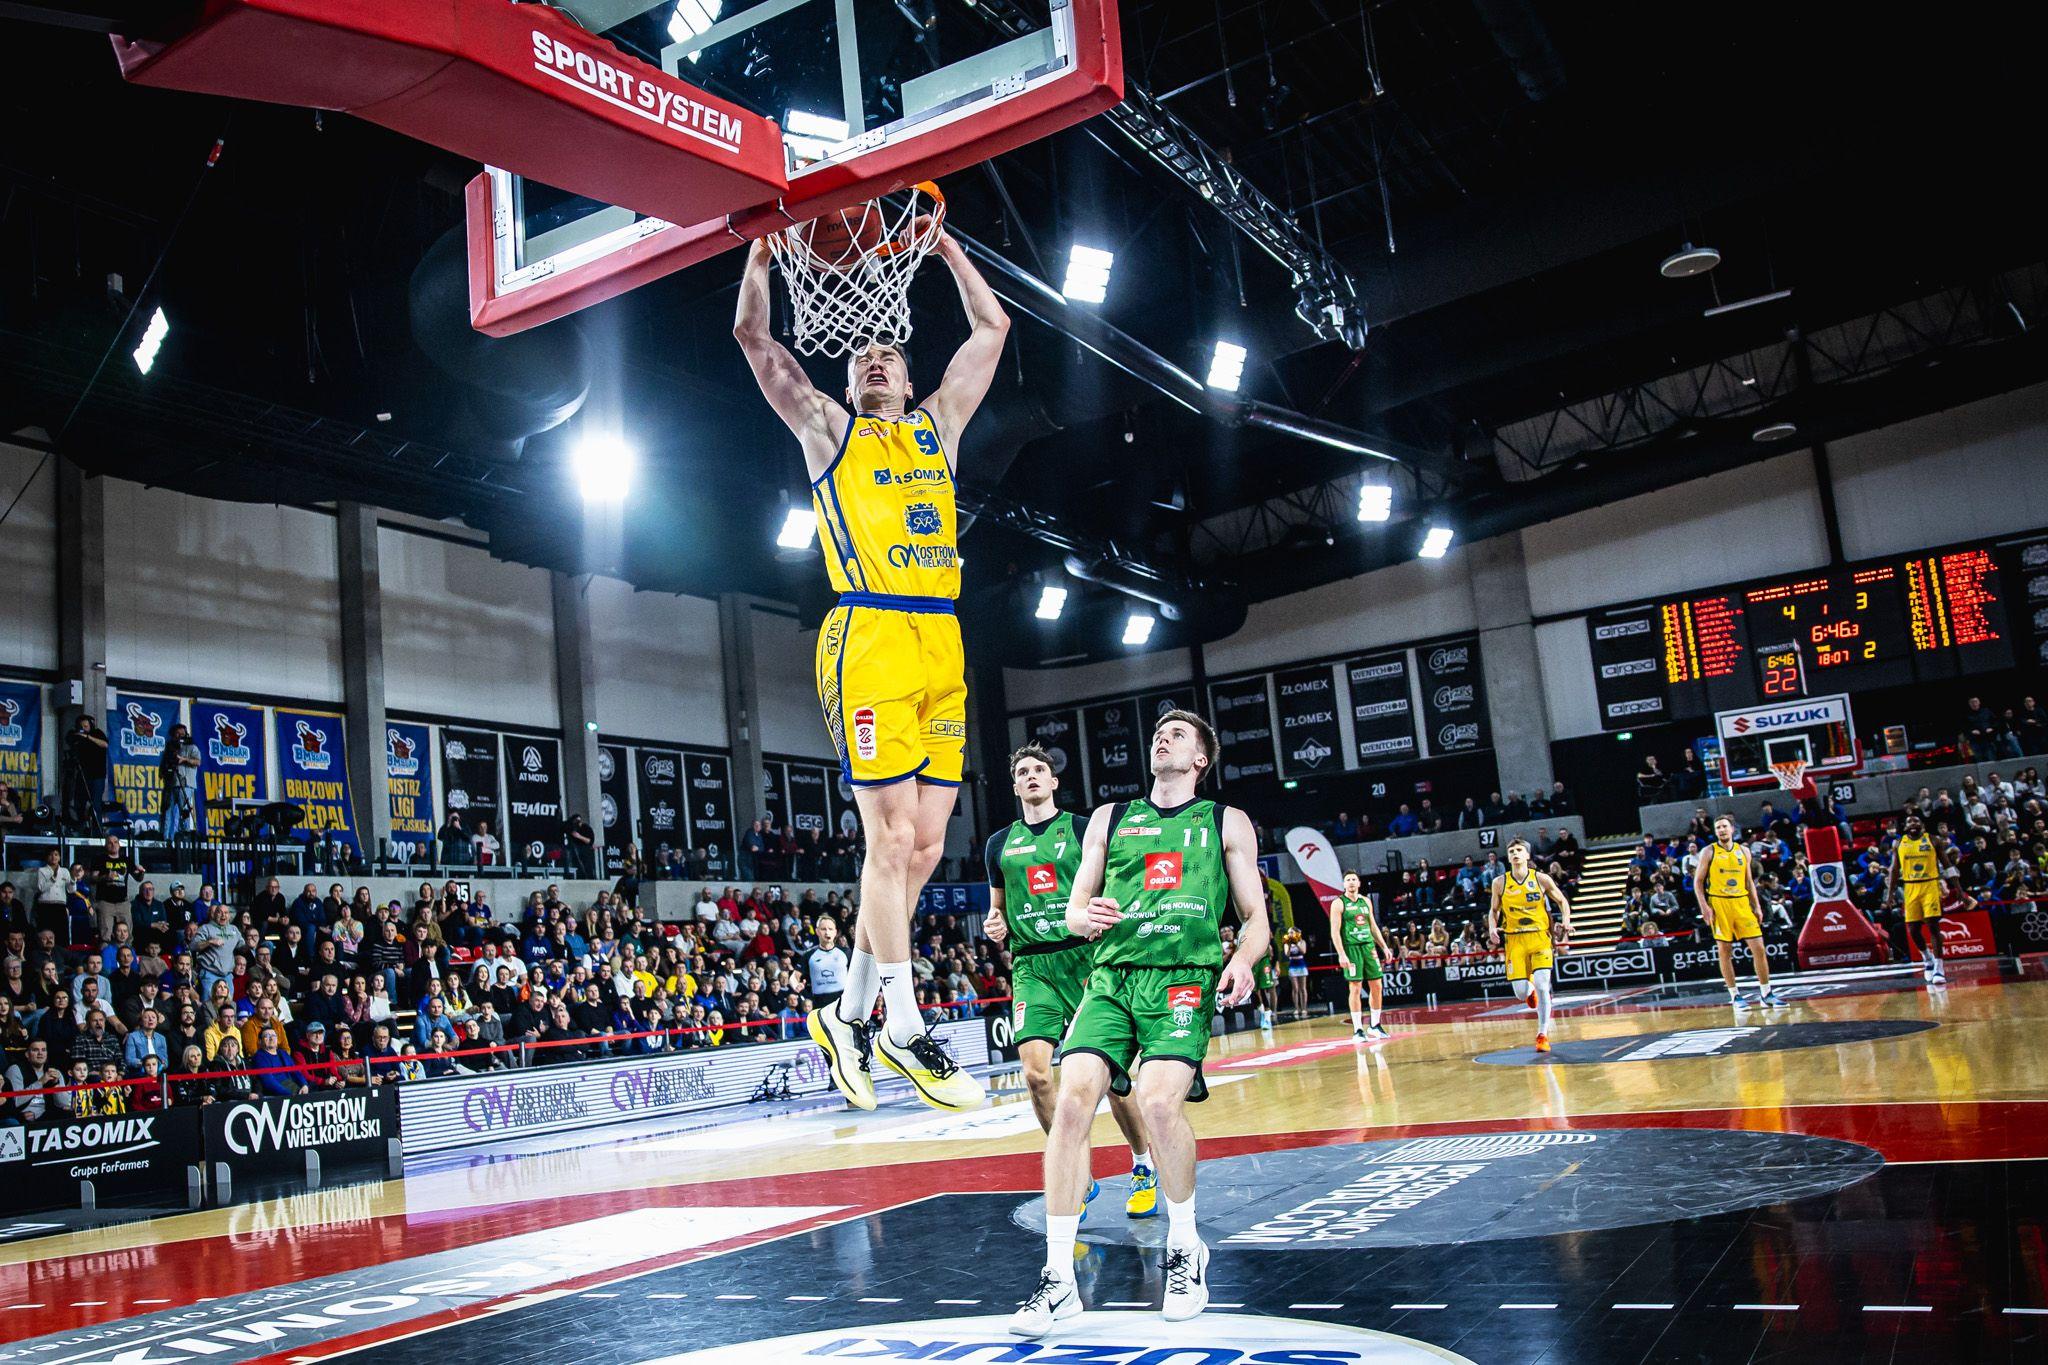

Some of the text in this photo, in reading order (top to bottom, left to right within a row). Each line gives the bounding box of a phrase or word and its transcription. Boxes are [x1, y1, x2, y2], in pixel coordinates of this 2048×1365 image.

[531, 30, 742, 145] SPORT SYSTEM
[914, 429, 940, 455] 9
[1856, 592, 1868, 610] 3
[1783, 605, 1796, 620] 4
[1818, 650, 1849, 666] 18:07
[1864, 641, 1877, 659] 2
[1767, 653, 1795, 669] 6:46
[1281, 679, 1329, 696] ZŁOMEX
[1764, 668, 1797, 694] 22
[1285, 711, 1333, 728] ZŁOMEX
[1755, 707, 1830, 728] SUZUKI
[203, 772, 256, 800] WICE
[519, 772, 548, 783] AT MOTO
[1371, 783, 1386, 795] 20
[1834, 786, 1852, 800] 38
[391, 797, 415, 818] LIGI
[1183, 828, 1208, 848] 11
[1480, 831, 1495, 844] 37
[1054, 842, 1067, 860] 7
[1033, 882, 1054, 890] ORLEN
[1150, 877, 1176, 885] ORLEN
[1172, 902, 1204, 911] NOWUM
[1823, 924, 1847, 932] ORLEN
[1952, 944, 1984, 954] Pekao
[1460, 964, 1507, 978] TASOM
[1562, 951, 1648, 977] arged
[290, 1093, 367, 1127] OSTRÓW
[28, 1117, 155, 1153] TASOMIX
[285, 1118, 381, 1149] WIELKOPOLSKI
[70, 1159, 150, 1178] Grupa ForFarmers
[238, 1280, 357, 1307] Grupa
